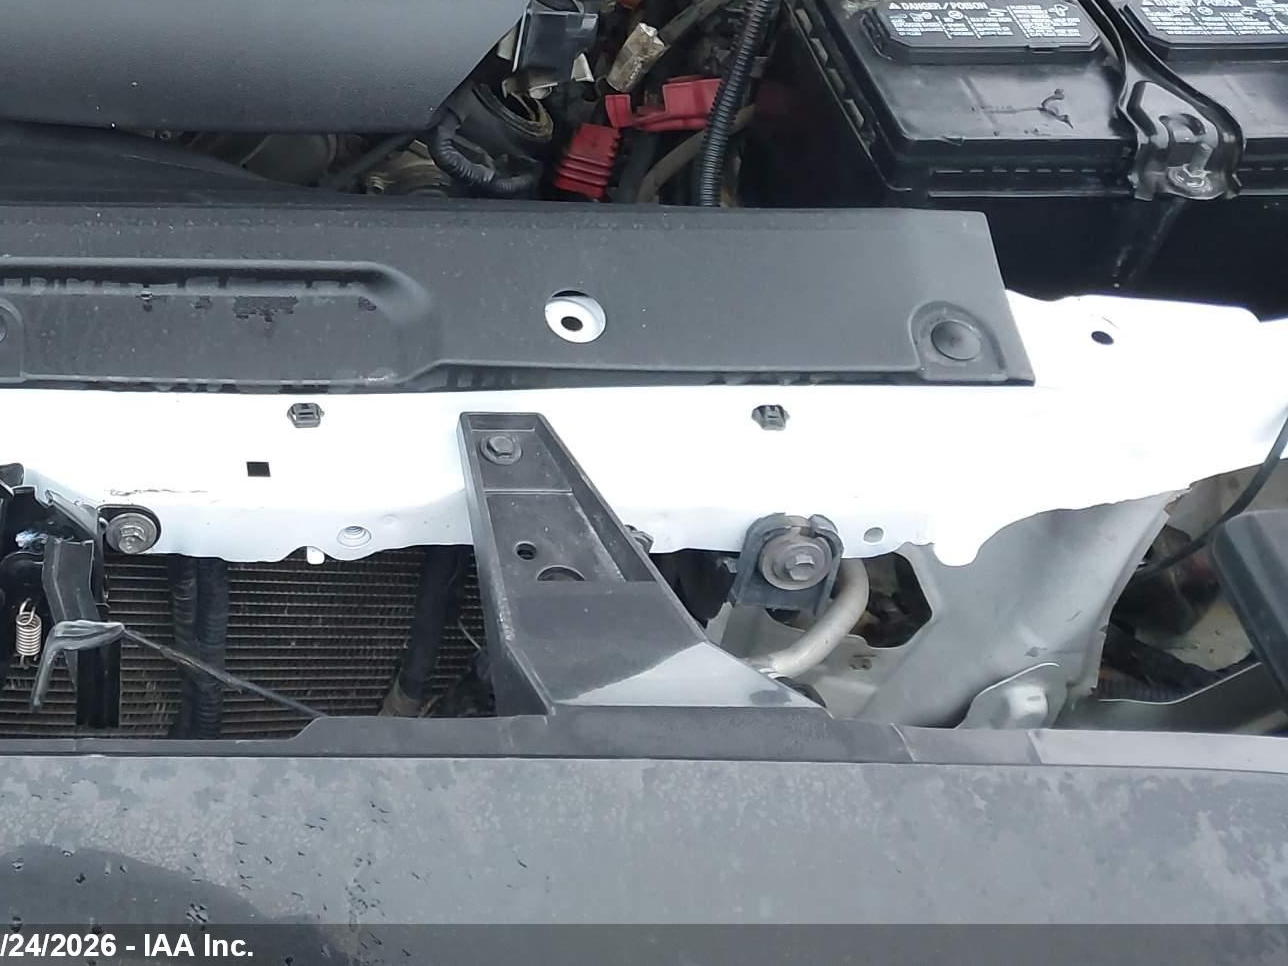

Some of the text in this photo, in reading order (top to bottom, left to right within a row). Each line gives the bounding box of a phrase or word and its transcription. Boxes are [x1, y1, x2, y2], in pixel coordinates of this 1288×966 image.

[900, 2, 943, 10] DANGER
[949, 2, 988, 10] POISON
[1154, 0, 1195, 7] DANGER
[1203, 0, 1242, 7] POISON
